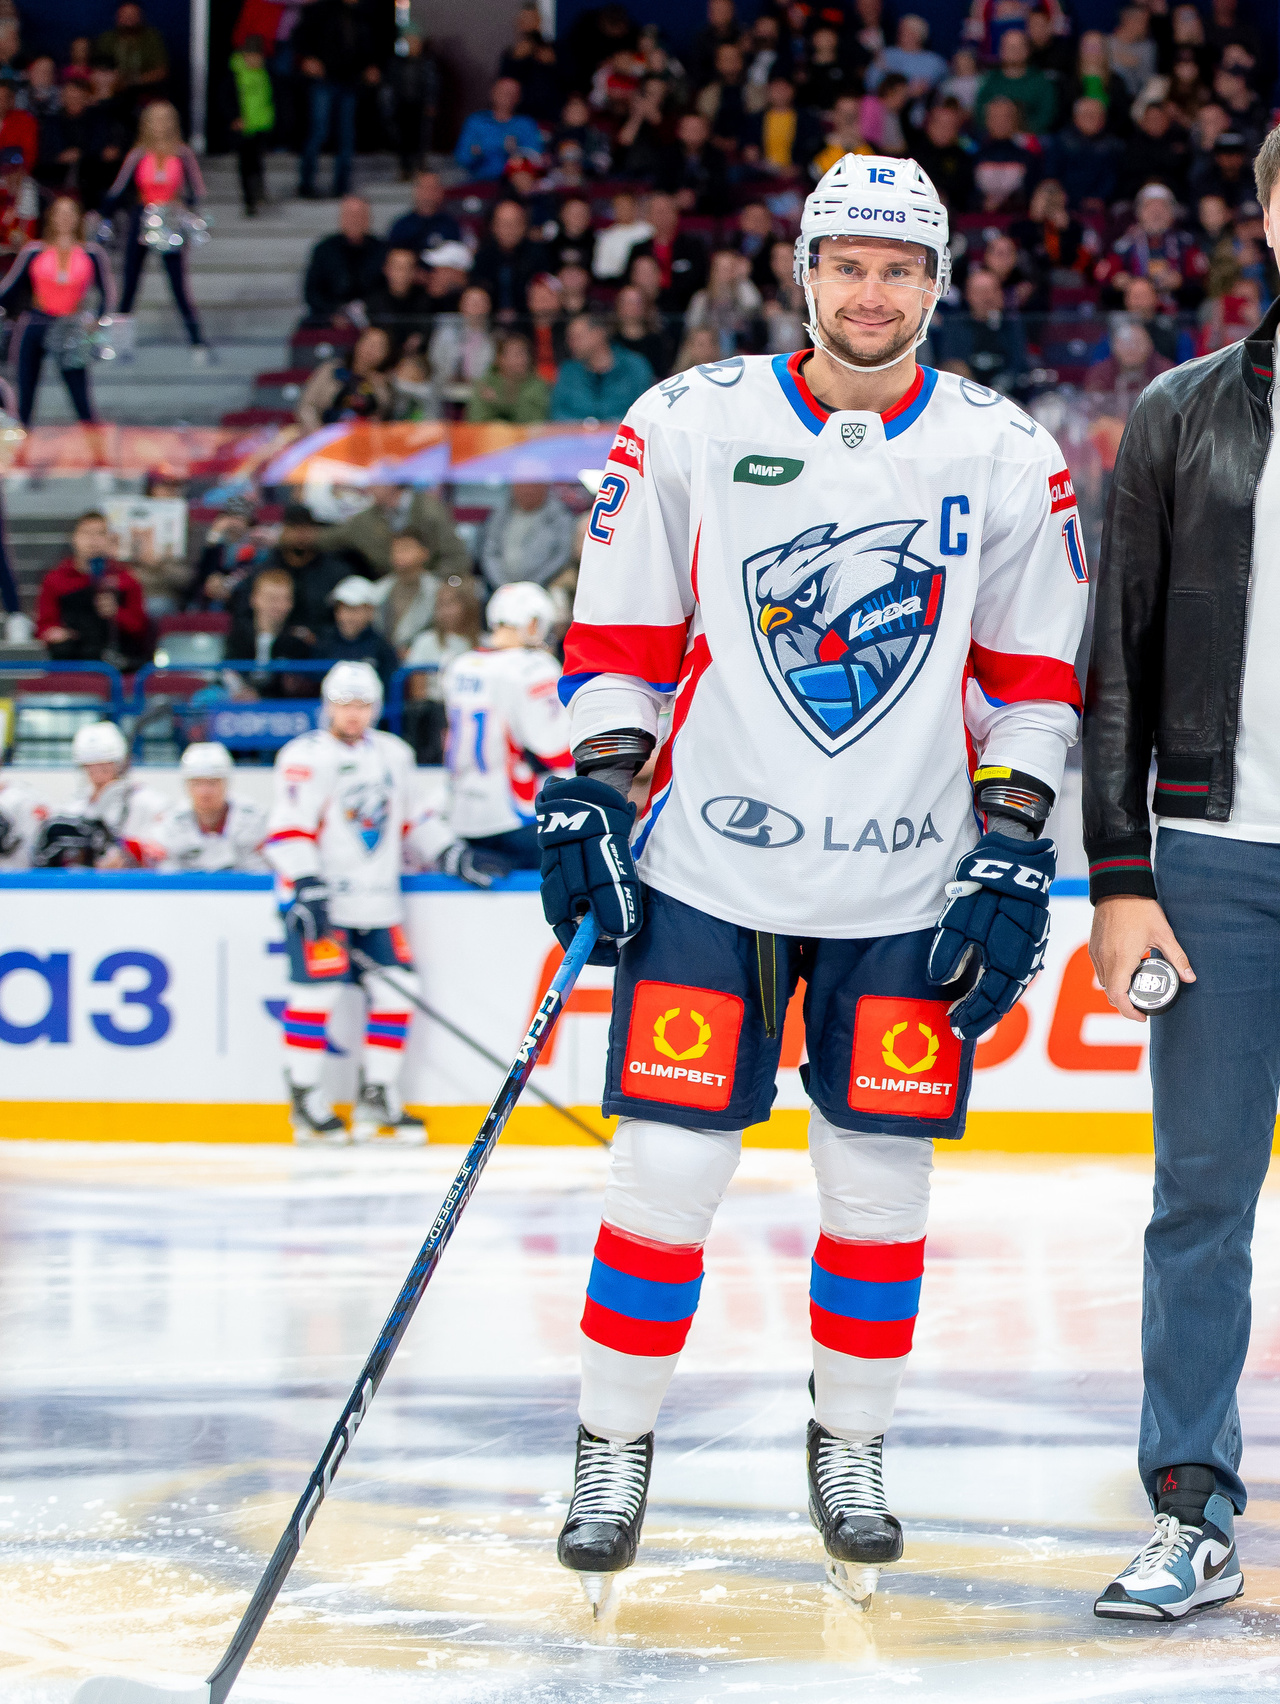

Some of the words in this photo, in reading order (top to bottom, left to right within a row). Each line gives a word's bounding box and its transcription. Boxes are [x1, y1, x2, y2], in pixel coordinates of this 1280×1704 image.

[866, 168, 896, 185] 12
[847, 206, 906, 223] согаз
[748, 463, 785, 477] МИР
[939, 494, 970, 556] C
[822, 811, 944, 855] LADA
[623, 886, 635, 924] CCM
[515, 989, 560, 1063] CCM
[629, 1061, 727, 1088] OLIMPBET
[855, 1075, 953, 1096] OLIMPBET
[428, 1158, 472, 1241] JETSPEED
[1162, 1485, 1178, 1493] AIR
